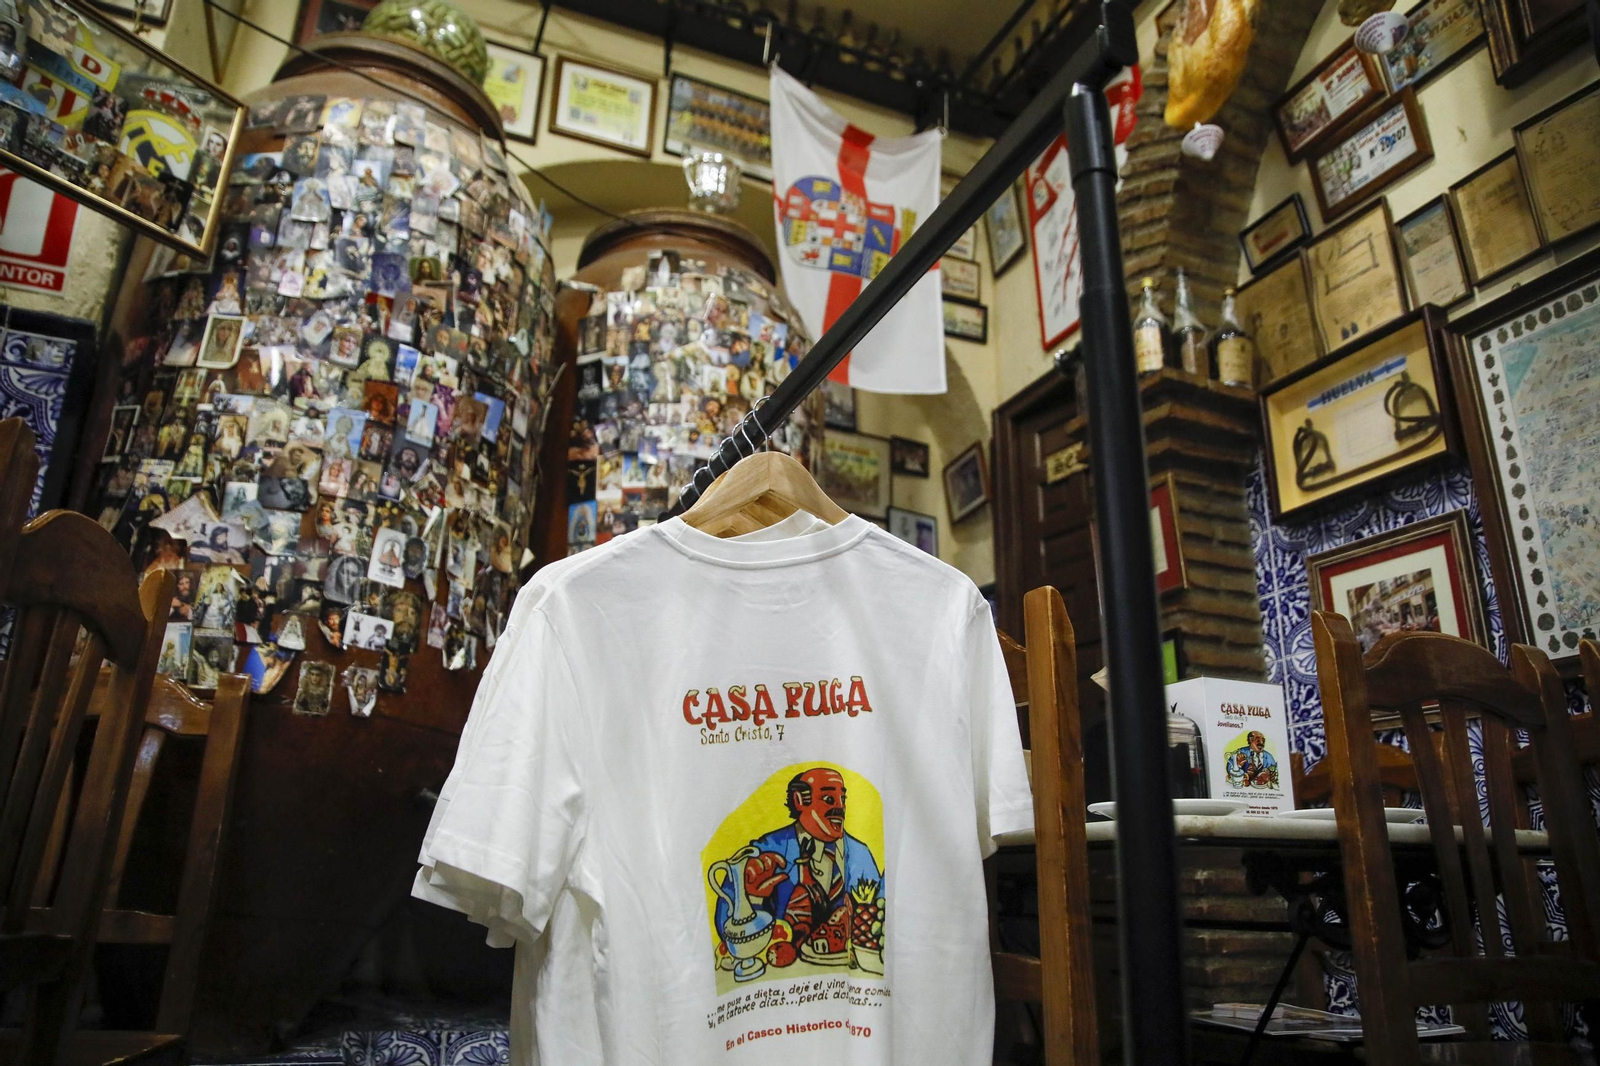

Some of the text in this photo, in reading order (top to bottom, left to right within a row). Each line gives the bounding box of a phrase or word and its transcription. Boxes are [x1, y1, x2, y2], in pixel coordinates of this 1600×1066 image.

[682, 675, 873, 730] CASA PUGA
[1220, 702, 1246, 717] CASA
[700, 724, 785, 745] Santo Cristo, 7
[727, 996, 742, 1011] puse
[745, 994, 751, 1002] a
[754, 988, 785, 999] dieta,
[813, 981, 823, 991] el
[826, 979, 846, 989] vino
[717, 1014, 725, 1025] en
[726, 1001, 756, 1020] catorce
[726, 1040, 735, 1051] En
[736, 1033, 745, 1045] el
[747, 1027, 782, 1042] Casco
[786, 1019, 843, 1035] Historico
